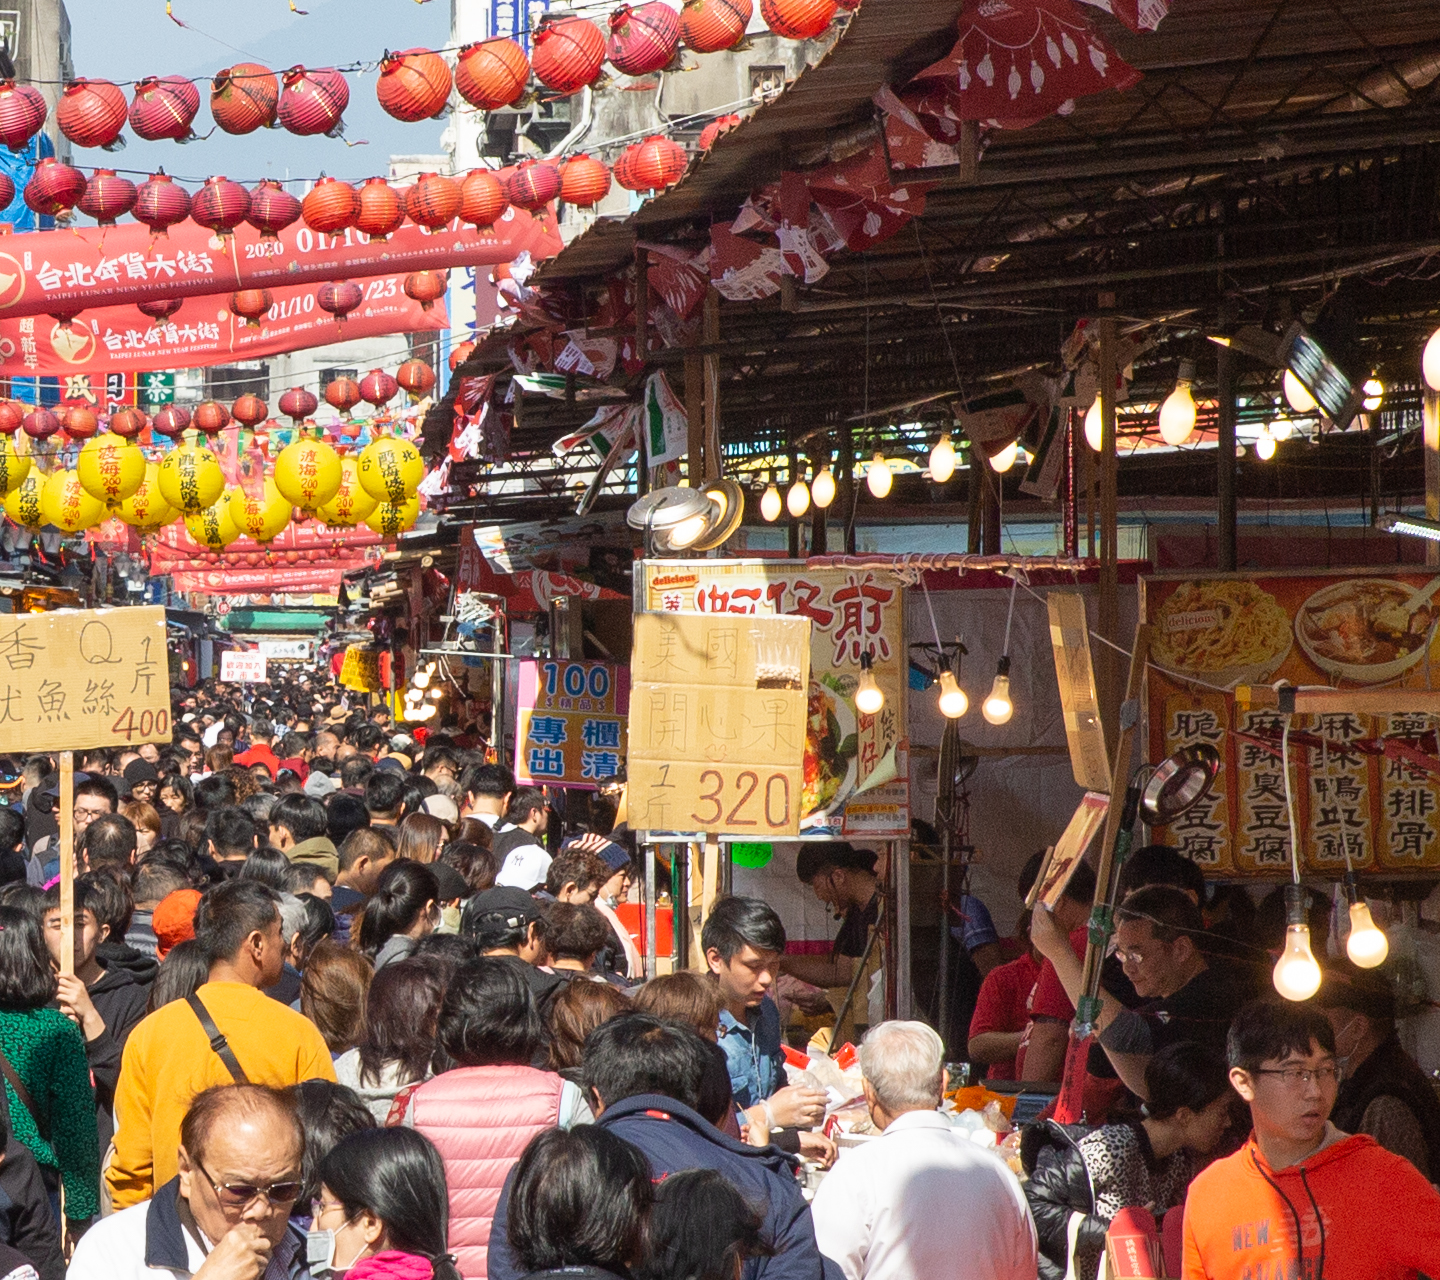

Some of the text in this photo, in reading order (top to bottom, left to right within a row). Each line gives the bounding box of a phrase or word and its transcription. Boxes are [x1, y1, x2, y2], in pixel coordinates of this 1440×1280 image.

[245, 241, 284, 260] 2020
[35, 249, 215, 291] 台北年貨大街
[102, 321, 220, 351] 台北年貨大街
[98, 444, 122, 497] 渡海200年
[299, 449, 319, 502] 渡海200年
[652, 574, 697, 586] delicious
[1166, 612, 1217, 630] delicious
[648, 625, 739, 679] 美國
[543, 663, 610, 699] 100
[112, 705, 169, 740] 400
[528, 716, 621, 748] 專櫃
[648, 690, 799, 754] 開心果
[528, 749, 620, 778] 出清
[691, 769, 791, 828] 320
[1171, 710, 1226, 863] 脆豆腐
[1242, 711, 1294, 863] 麻辣臭豆腐
[1231, 1221, 1270, 1253] NEW
